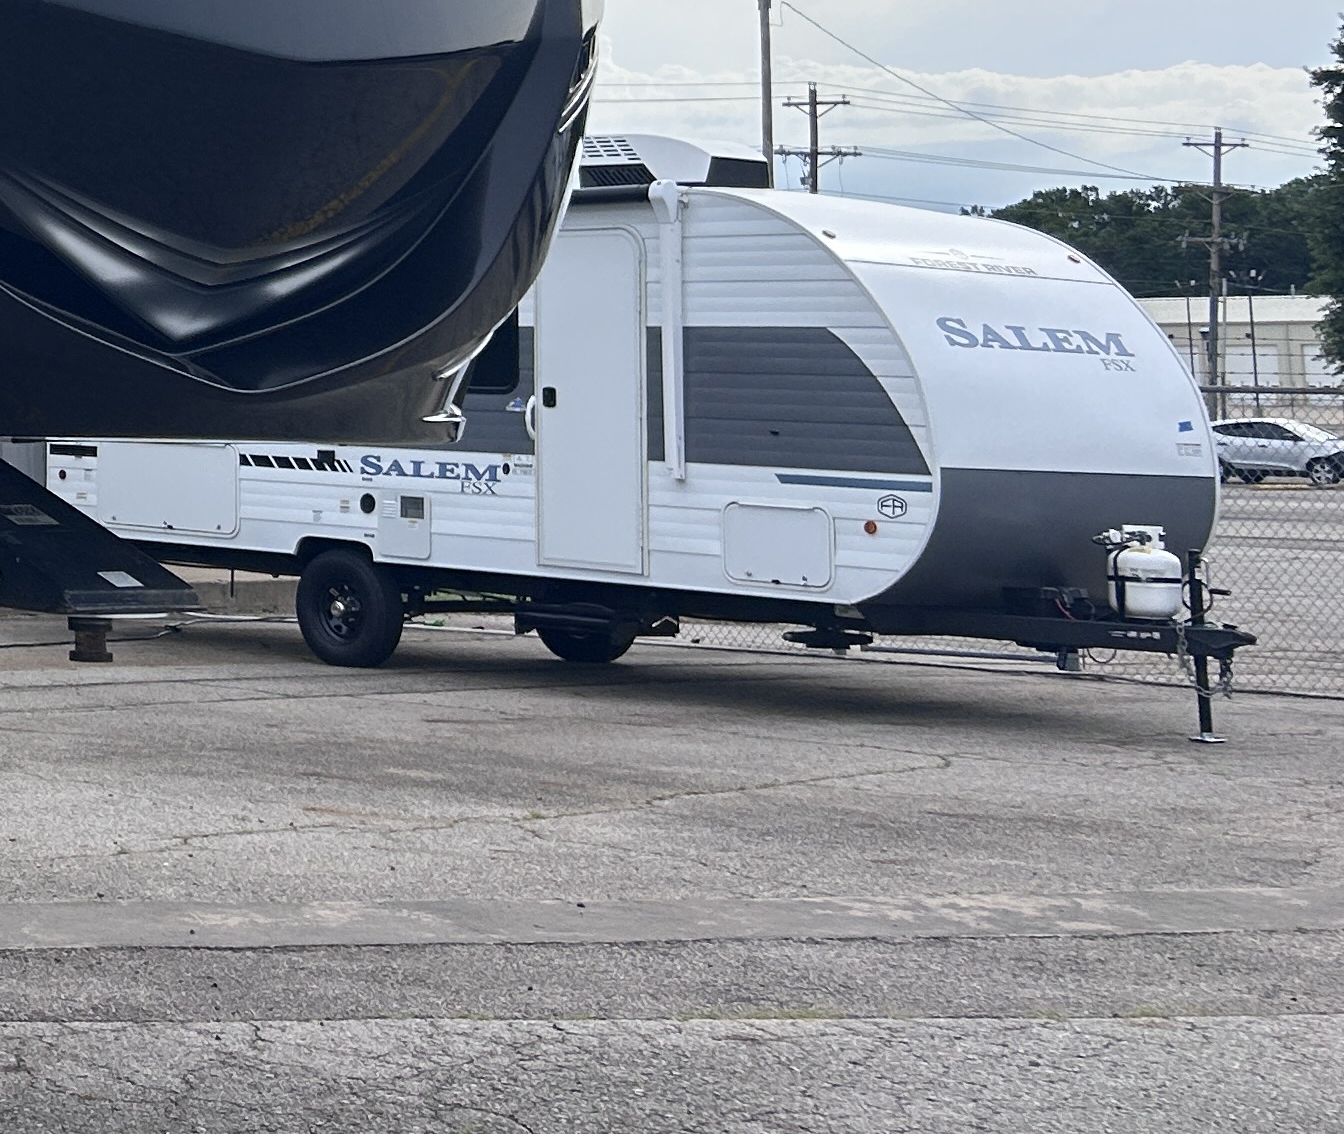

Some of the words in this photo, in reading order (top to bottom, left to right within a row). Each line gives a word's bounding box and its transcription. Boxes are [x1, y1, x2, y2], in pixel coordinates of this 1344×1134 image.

[908, 256, 981, 272] FOREST
[981, 263, 1039, 276] RIVER
[460, 481, 499, 496] FSX
